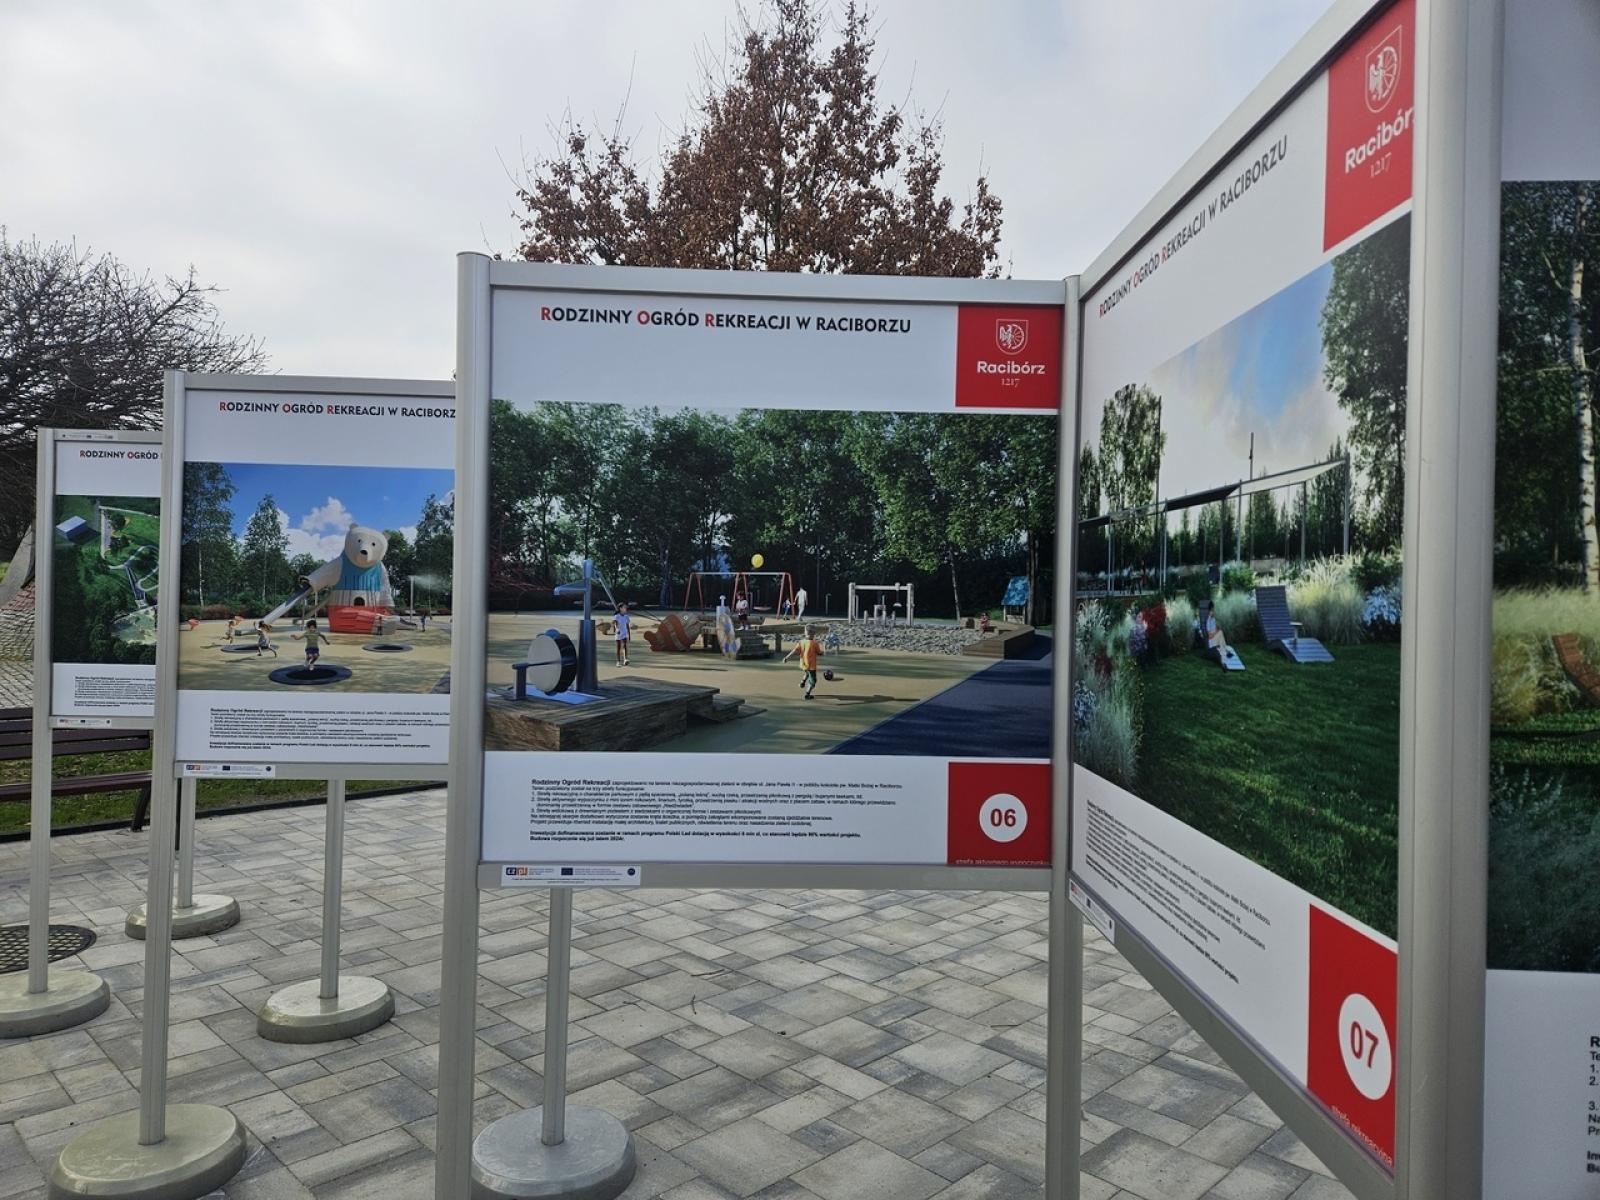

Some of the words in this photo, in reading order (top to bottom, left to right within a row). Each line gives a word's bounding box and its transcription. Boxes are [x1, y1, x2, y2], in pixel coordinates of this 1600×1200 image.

[1345, 108, 1414, 174] Racibór
[1099, 276, 1133, 318] RODZINNY
[1133, 253, 1160, 288] OGRÓD
[1161, 209, 1206, 263] REKREACJI
[1208, 197, 1218, 221] W
[1219, 134, 1287, 213] RACIBORZU
[541, 306, 632, 324] RODZINNY
[637, 308, 700, 327] OGRÓD
[705, 313, 791, 330] REKREACJI
[796, 316, 811, 330] W
[816, 317, 911, 333] RACIBORZU
[977, 360, 1046, 375] Racibórz
[1001, 378, 1021, 388] 1217
[219, 401, 279, 413] RODZINNY
[282, 401, 324, 414] OGRÓD
[326, 404, 384, 416] REKREACJI
[388, 406, 398, 416] W
[80, 449, 125, 459] RODZINNY
[127, 449, 159, 460] OGRÓD
[990, 808, 1017, 827] 06
[1350, 1020, 1379, 1069] 07
